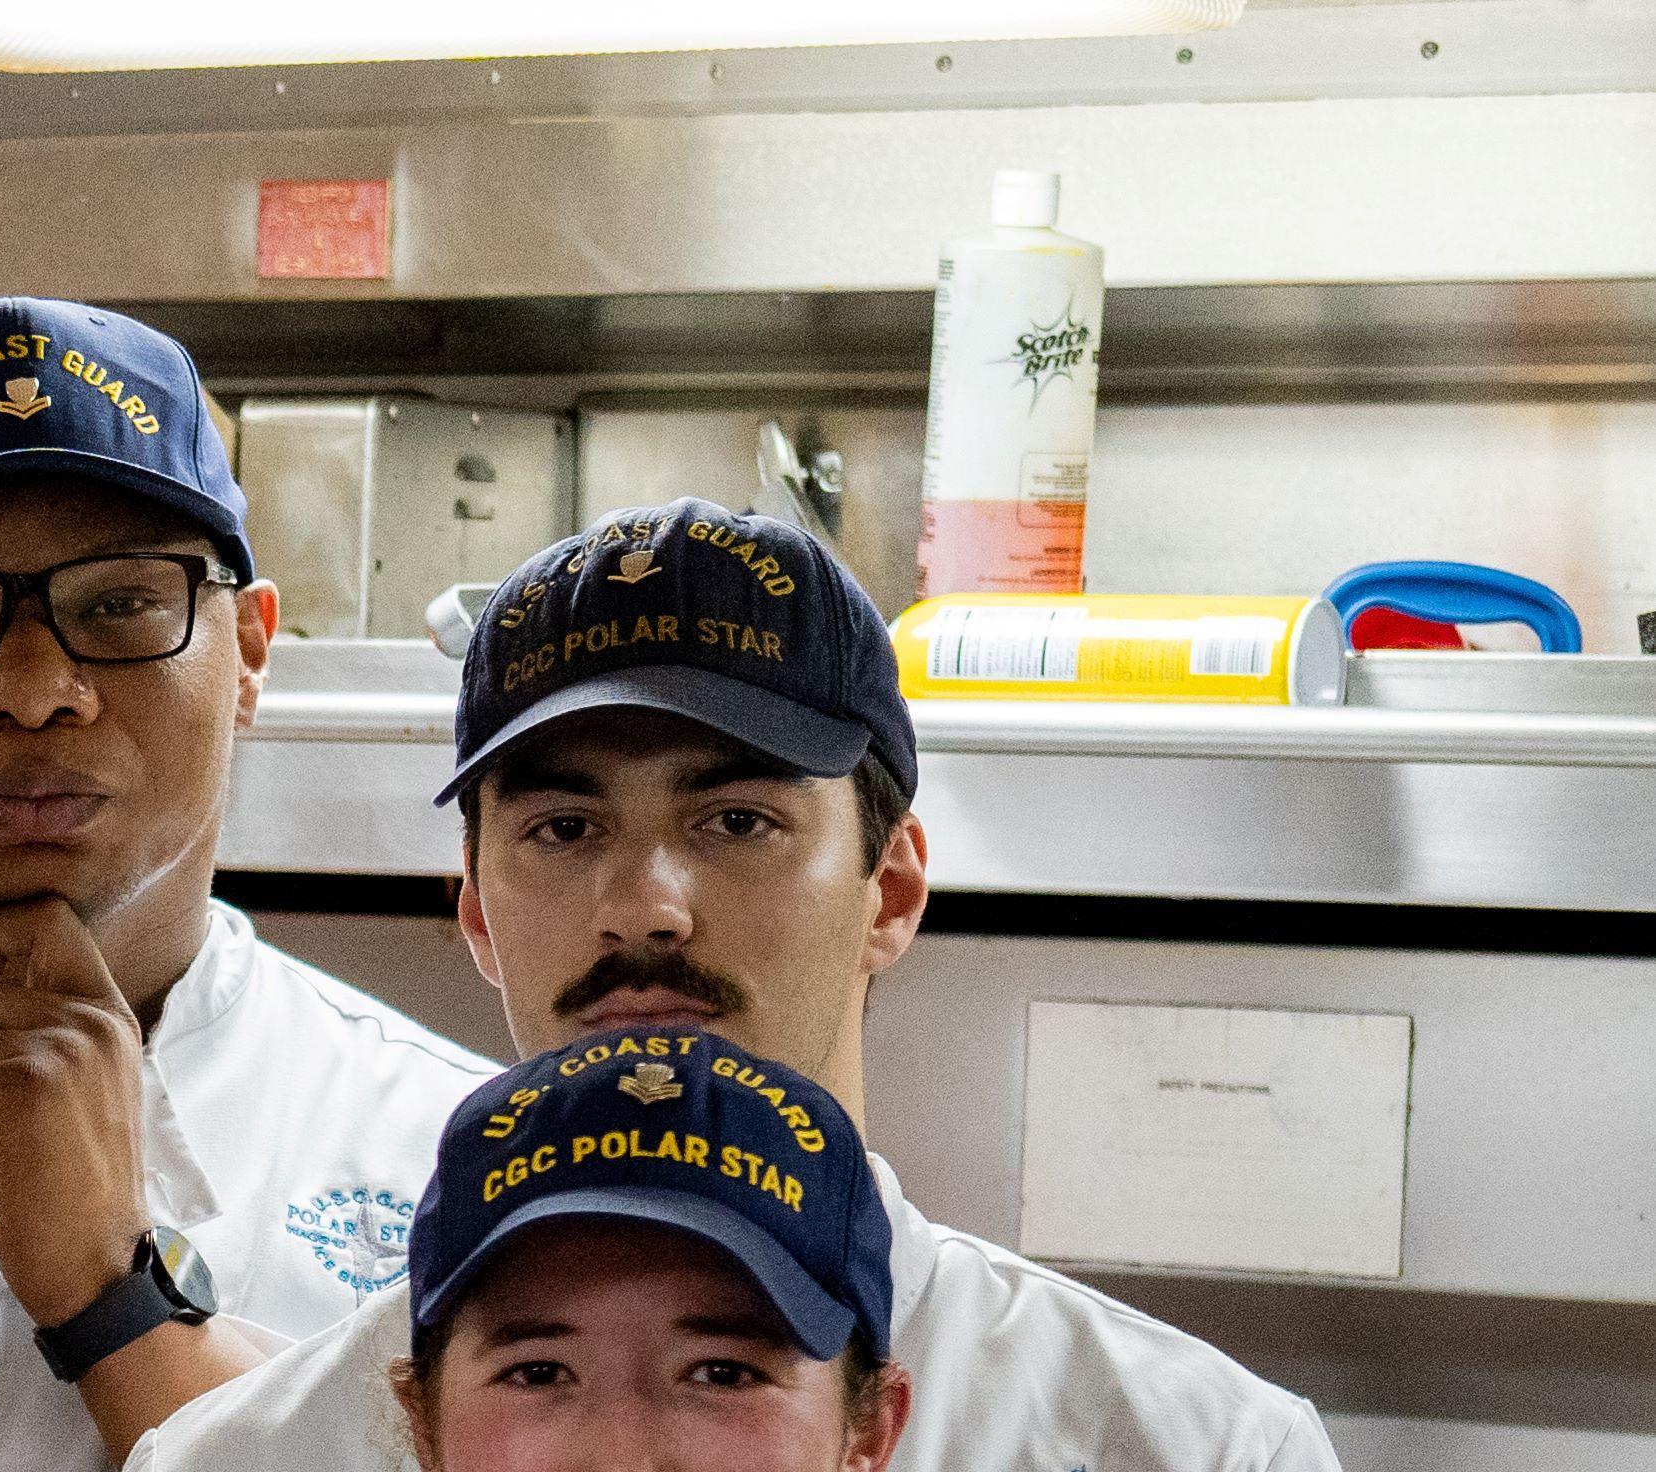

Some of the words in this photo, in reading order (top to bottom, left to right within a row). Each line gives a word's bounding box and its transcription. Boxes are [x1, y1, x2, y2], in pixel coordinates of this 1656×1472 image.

[61, 349, 160, 437] GUARD
[566, 516, 674, 575] COAST
[687, 521, 796, 598] GUARD
[503, 643, 556, 694] CGC
[564, 614, 680, 663] POLAR
[697, 619, 785, 663] STAR
[482, 1085, 552, 1140] U.S.
[559, 1036, 701, 1078] COAST
[710, 1057, 826, 1154] GUARD
[482, 1145, 558, 1203] CGC
[572, 1129, 710, 1170] POLAR
[720, 1151, 803, 1213] STAR
[380, 1224, 410, 1243] ST
